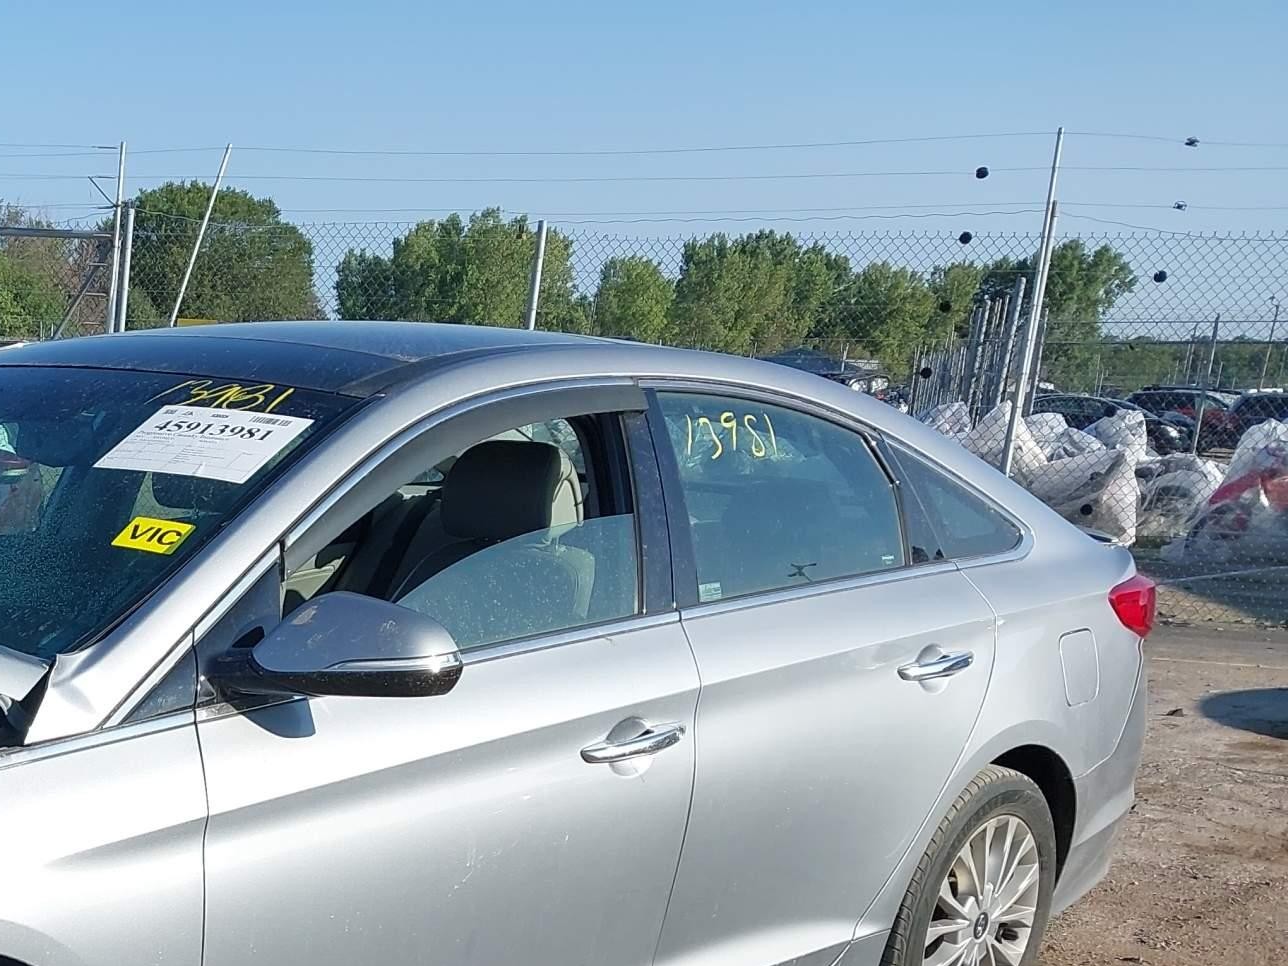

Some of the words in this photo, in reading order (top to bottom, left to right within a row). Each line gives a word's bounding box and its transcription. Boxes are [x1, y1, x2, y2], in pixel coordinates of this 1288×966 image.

[154, 419, 274, 441] 45913981
[685, 411, 777, 460] 13981
[130, 524, 183, 546] VIC
